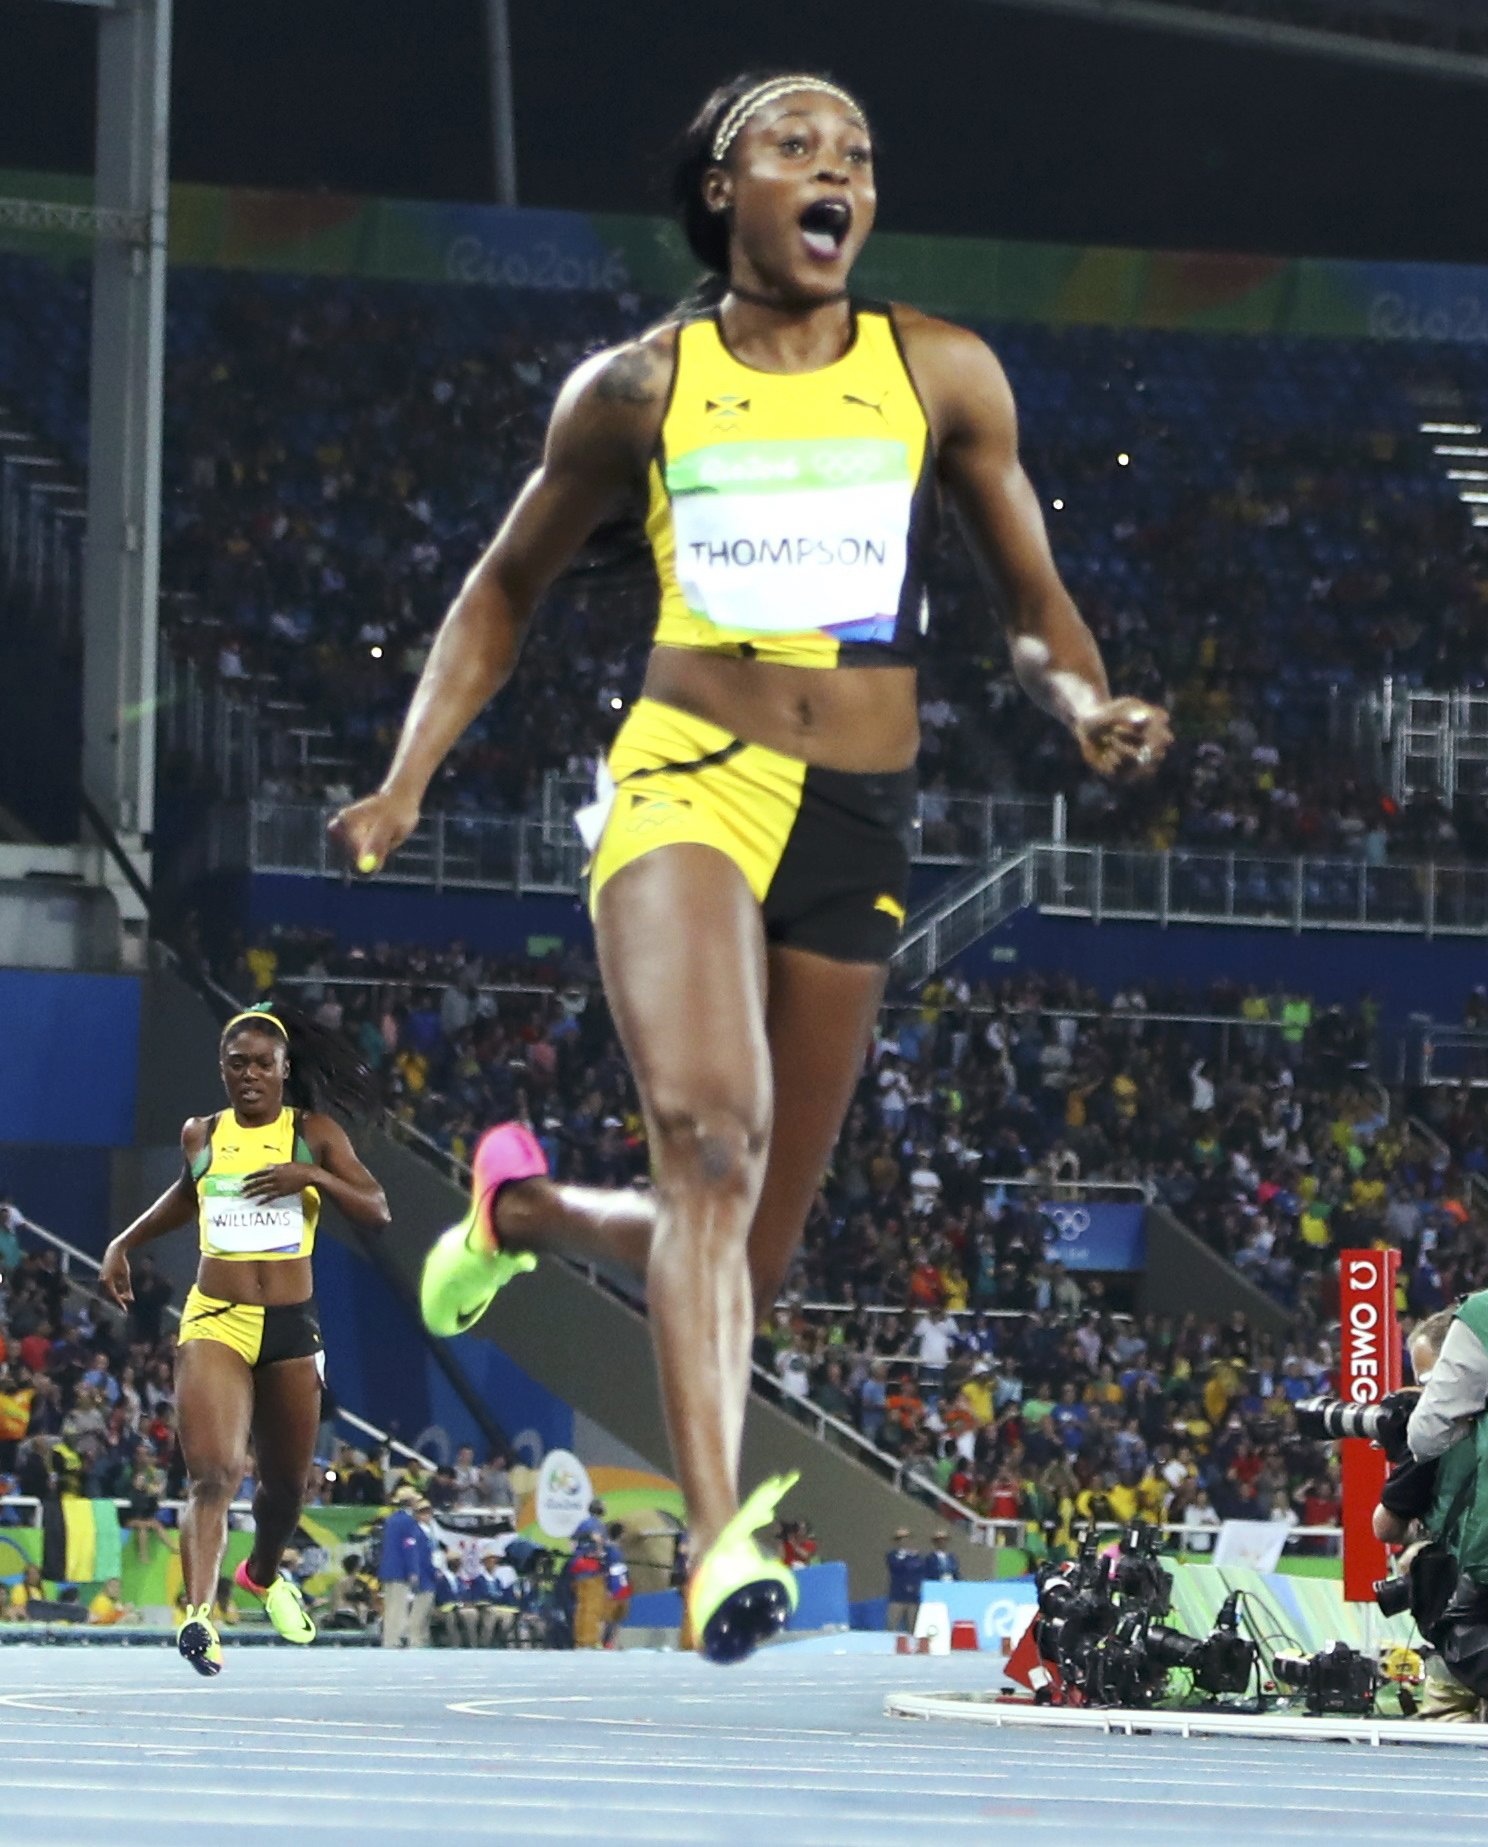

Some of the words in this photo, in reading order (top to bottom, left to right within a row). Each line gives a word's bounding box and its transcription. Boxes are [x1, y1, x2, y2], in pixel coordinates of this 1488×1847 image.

[447, 235, 629, 288] Rio2016
[689, 537, 886, 568] THOMPSON
[212, 1210, 291, 1228] WILLIAMS
[1350, 1302, 1378, 1404] OMEG
